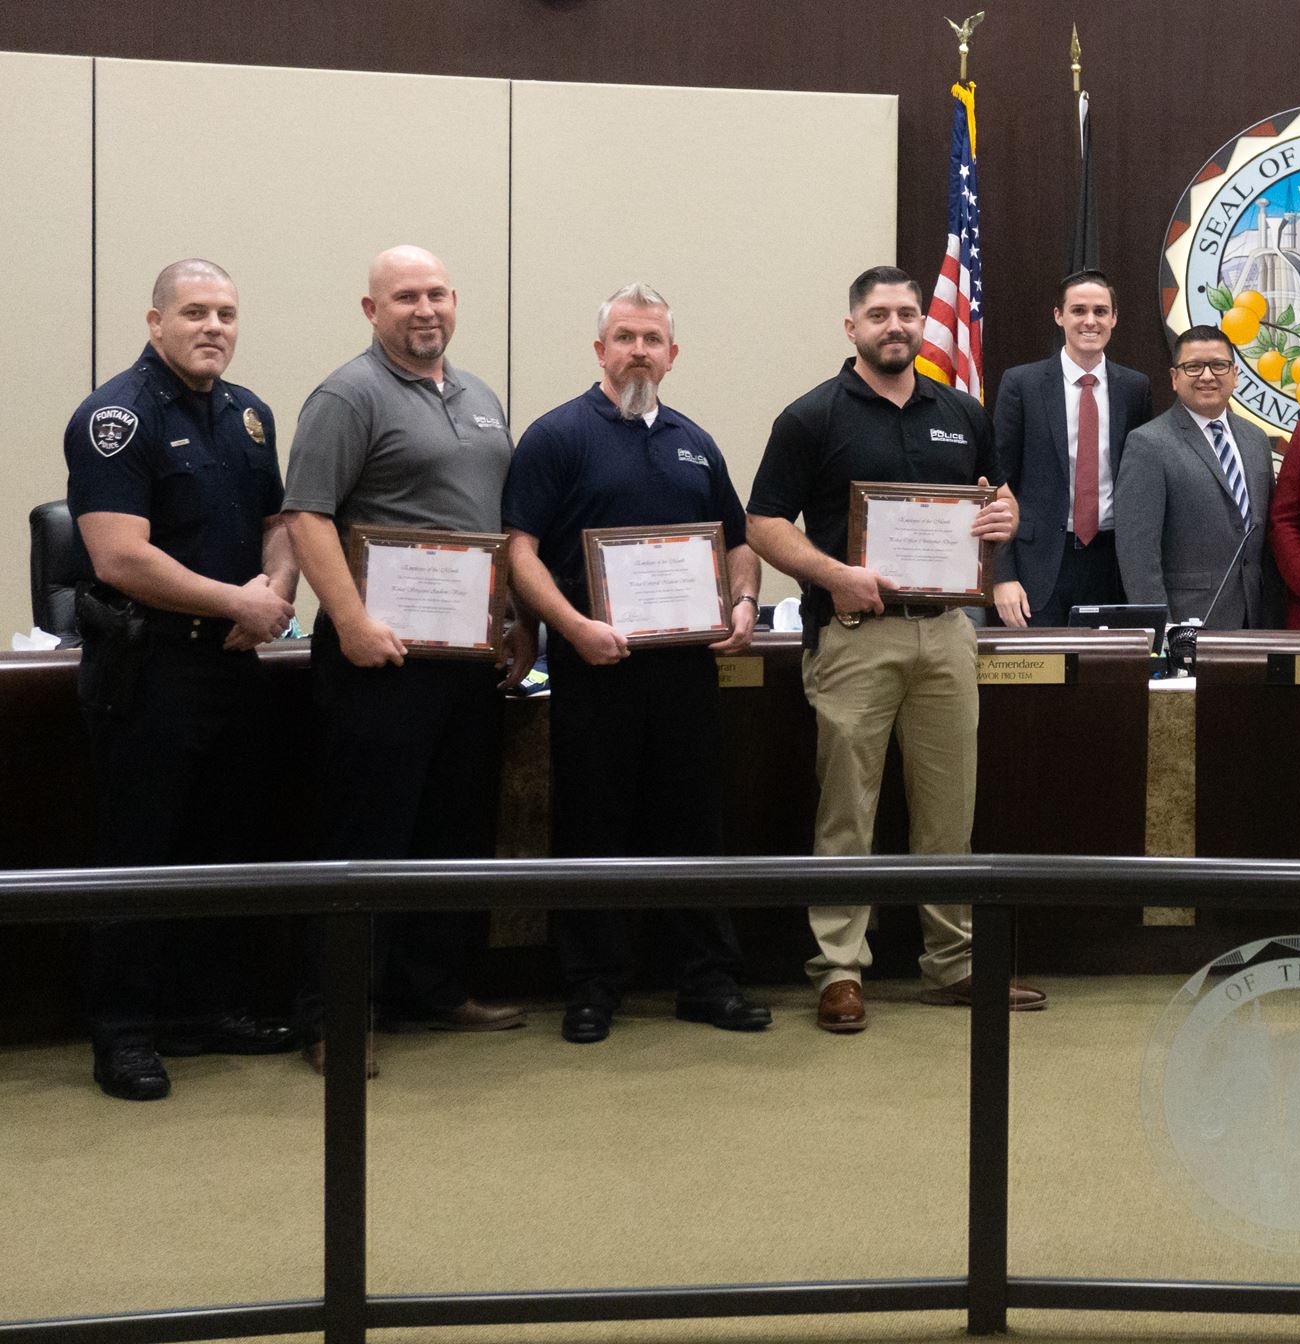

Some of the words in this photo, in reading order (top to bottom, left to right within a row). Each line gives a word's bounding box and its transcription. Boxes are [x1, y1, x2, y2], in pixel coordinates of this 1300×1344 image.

[1199, 176, 1254, 256] SEAL
[1258, 147, 1296, 179] OF
[96, 410, 135, 426] FONTANA
[930, 429, 964, 440] POLICE
[98, 440, 120, 449] POLICE
[987, 659, 1045, 669] Armendarez
[1001, 672, 1016, 680] PRO
[1018, 672, 1033, 680] TEM
[1224, 973, 1256, 1001] OF
